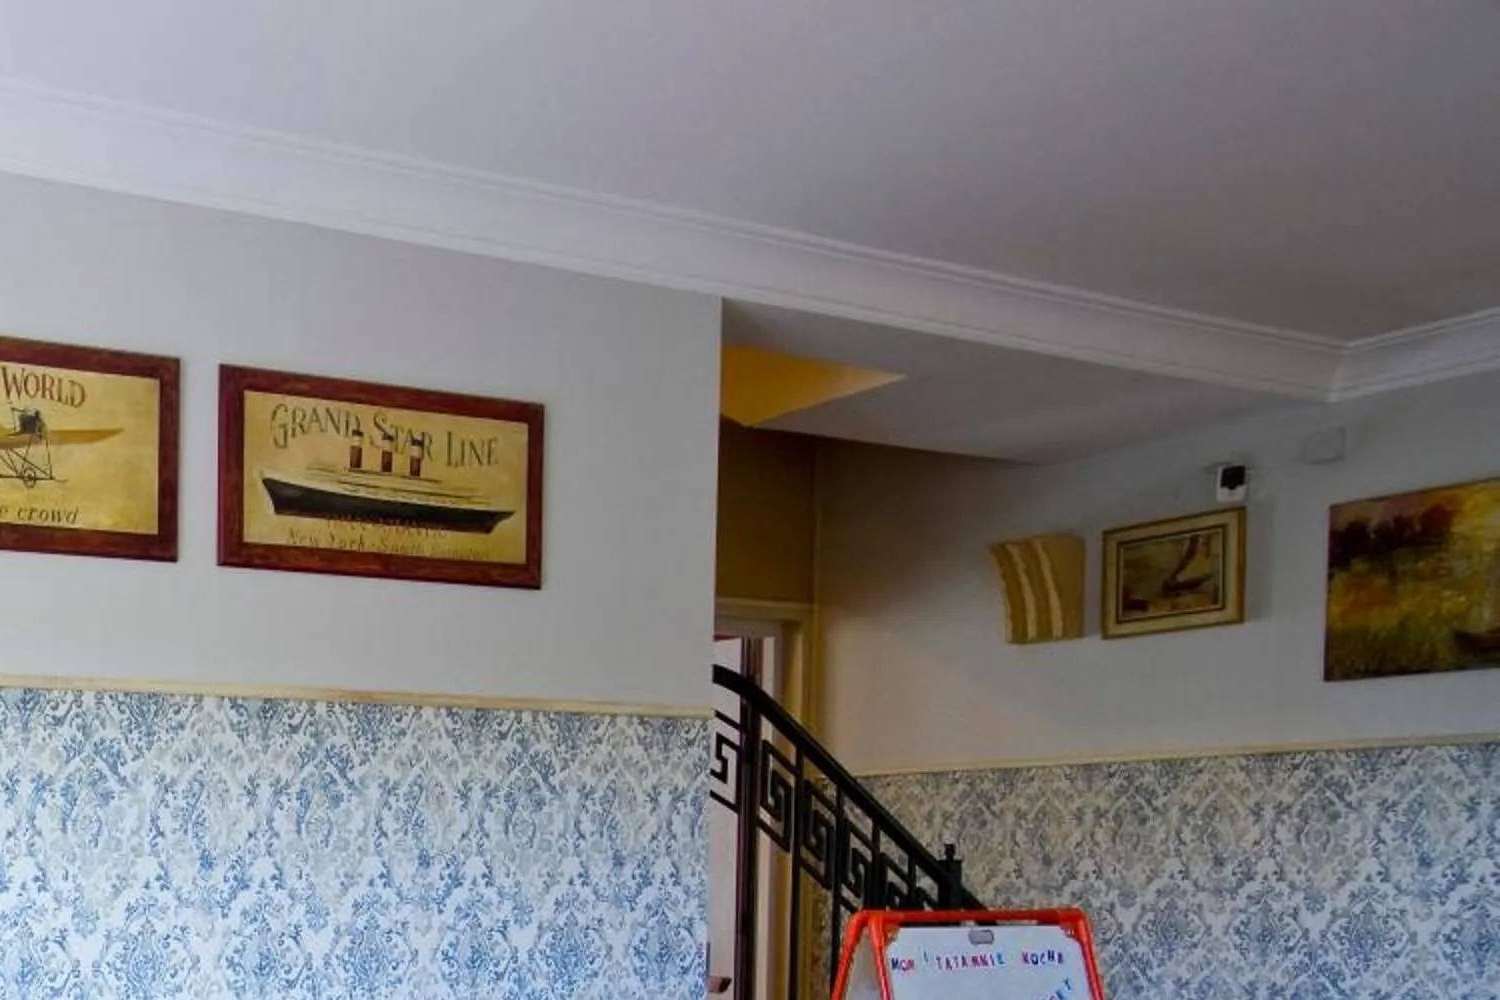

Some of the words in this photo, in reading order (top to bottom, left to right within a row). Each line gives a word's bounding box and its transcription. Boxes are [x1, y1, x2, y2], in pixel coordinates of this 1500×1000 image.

[1, 366, 87, 409] WORLD
[269, 403, 362, 450] GRAND
[370, 409, 433, 460] STAR
[445, 431, 500, 469] LINE
[16, 504, 80, 526] crowd
